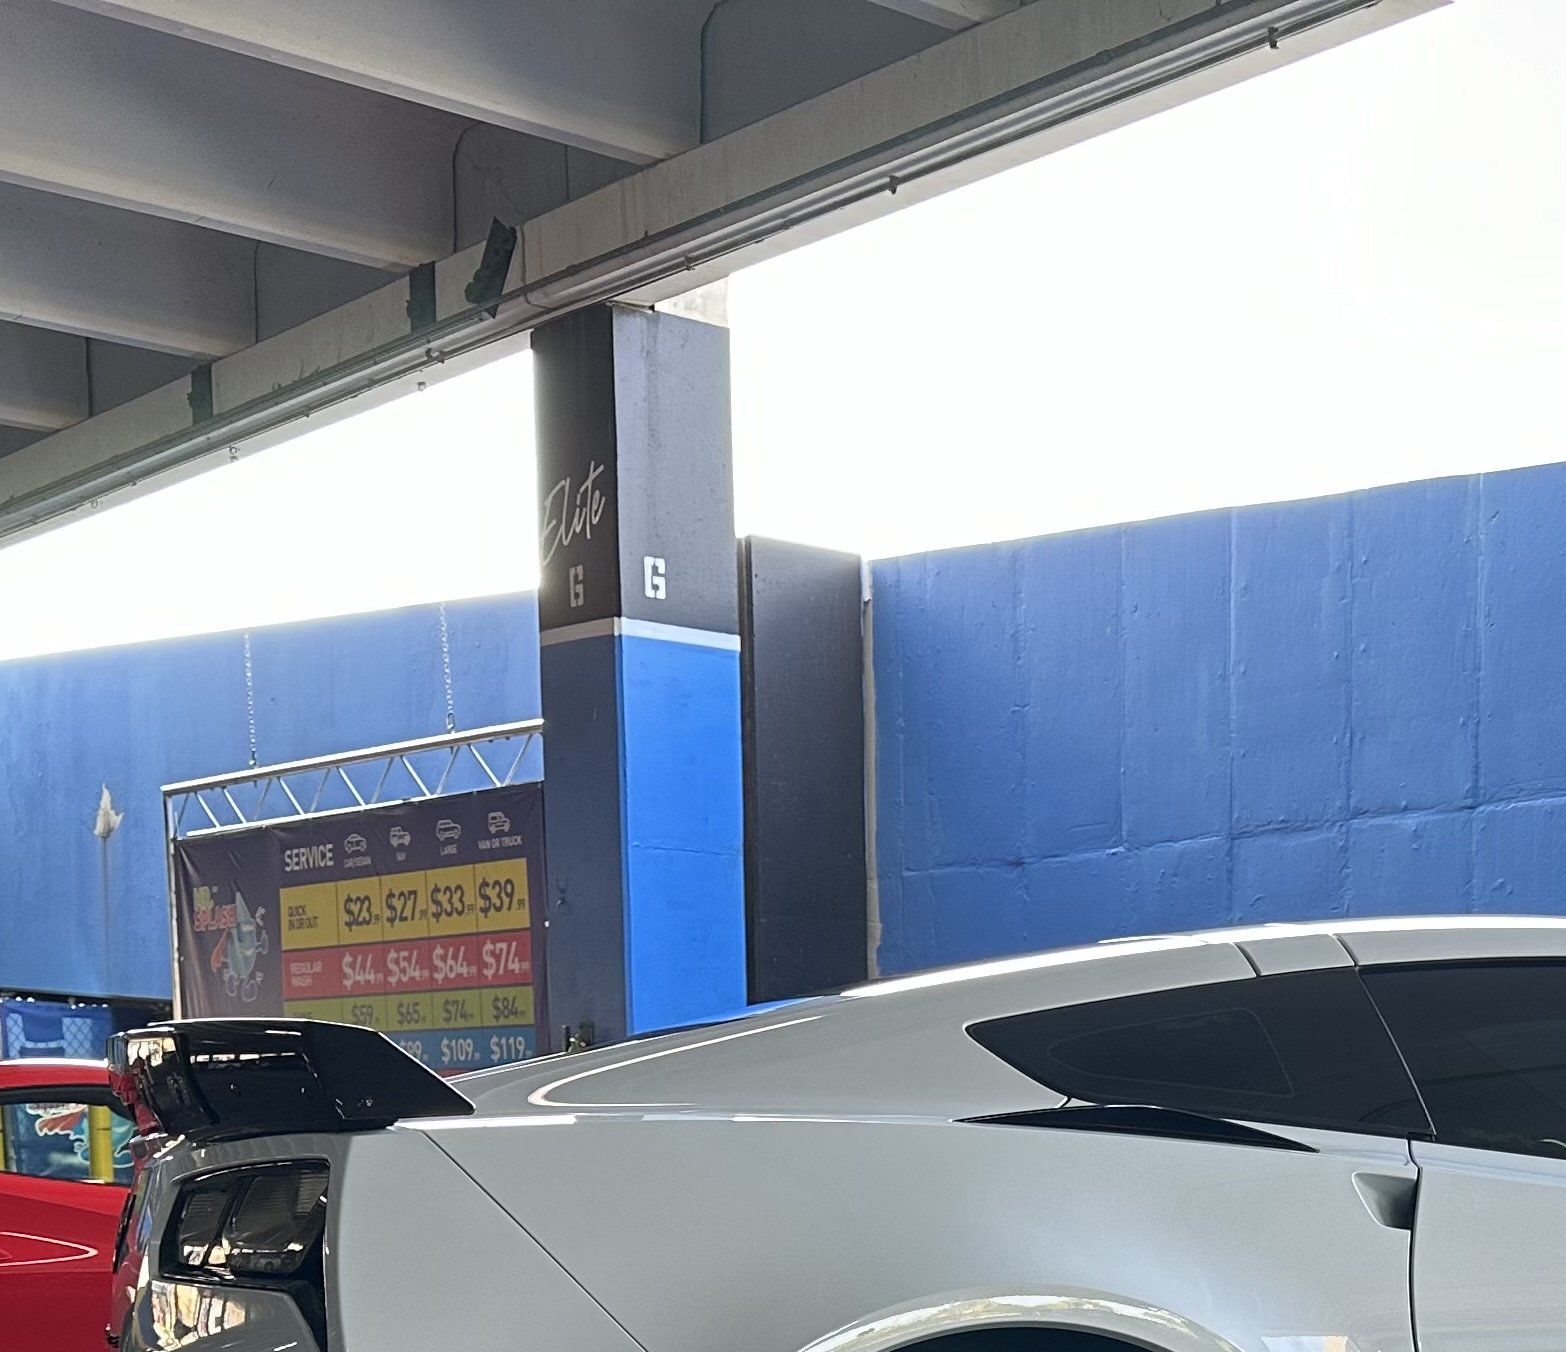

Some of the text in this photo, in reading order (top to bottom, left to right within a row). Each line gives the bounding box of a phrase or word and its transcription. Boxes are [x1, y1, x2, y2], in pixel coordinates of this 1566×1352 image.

[540, 460, 606, 567] Elite
[569, 564, 584, 608] G
[643, 555, 667, 600] G
[284, 843, 334, 872] SERVICE
